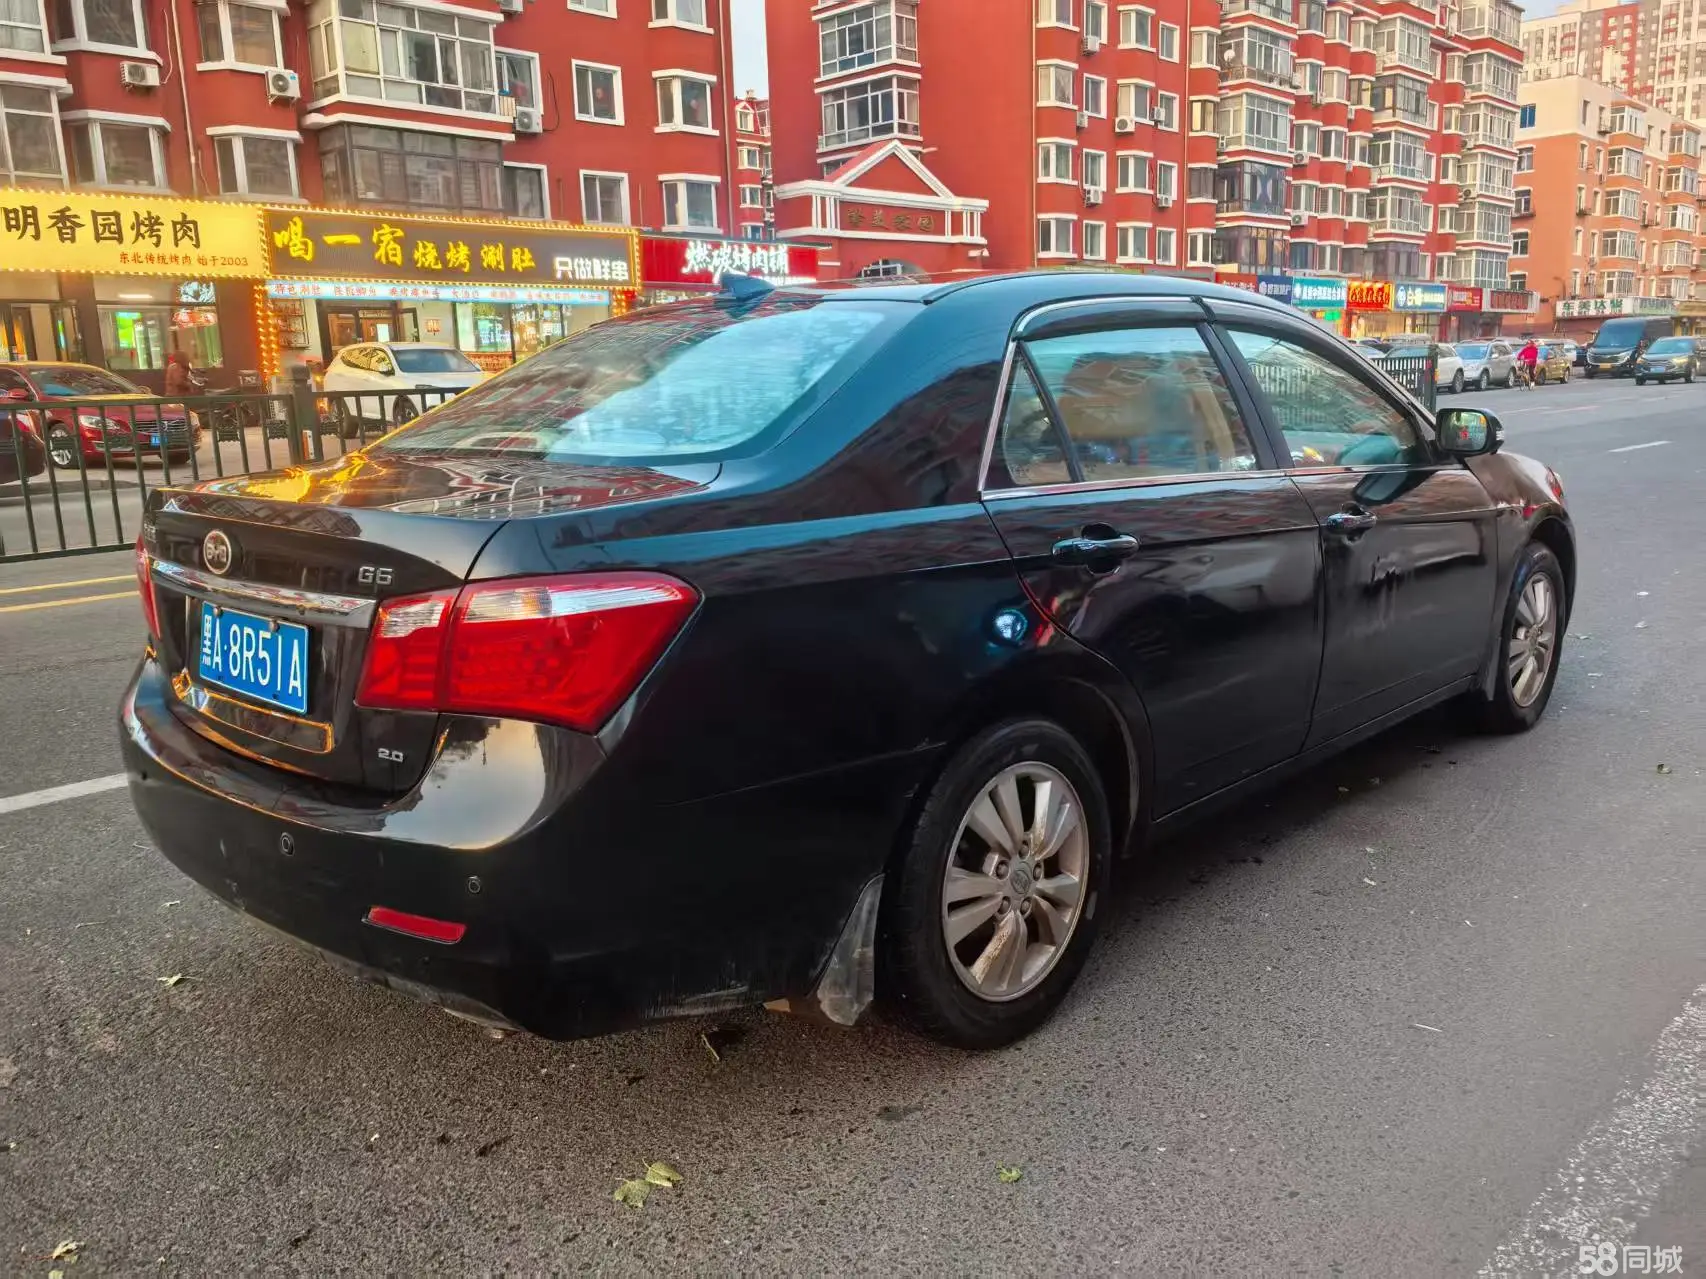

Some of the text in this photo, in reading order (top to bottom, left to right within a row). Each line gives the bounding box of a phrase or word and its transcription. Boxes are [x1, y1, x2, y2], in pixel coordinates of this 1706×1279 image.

[2, 205, 201, 249] 明香园烤肉
[119, 251, 249, 267] 东北传统烤肉 始于2003
[555, 256, 629, 281] 只做鲜串
[359, 566, 392, 585] G6
[378, 748, 403, 763] 2.0
